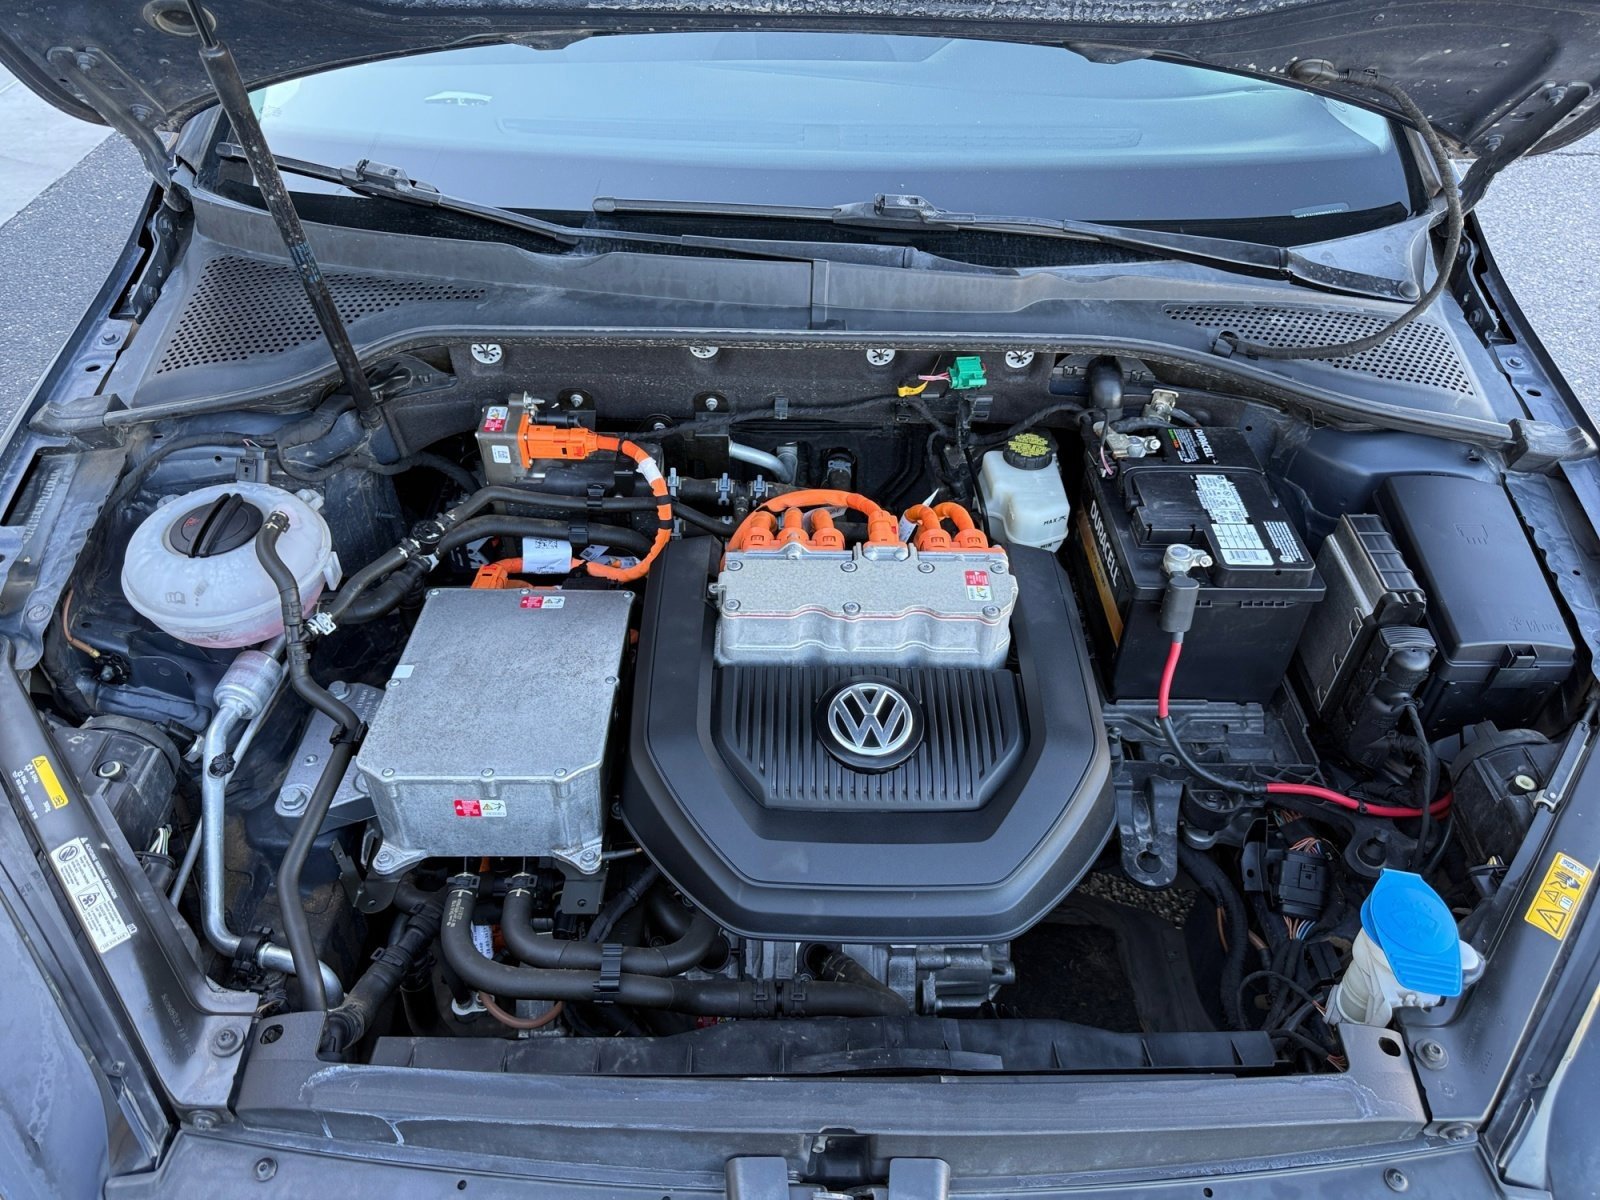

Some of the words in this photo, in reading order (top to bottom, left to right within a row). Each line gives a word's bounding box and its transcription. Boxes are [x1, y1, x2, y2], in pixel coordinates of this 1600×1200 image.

[1194, 429, 1214, 457] DURACELL
[1044, 518, 1058, 526] MAX
[1090, 499, 1118, 587] DURACELL
[828, 683, 913, 756] VW
